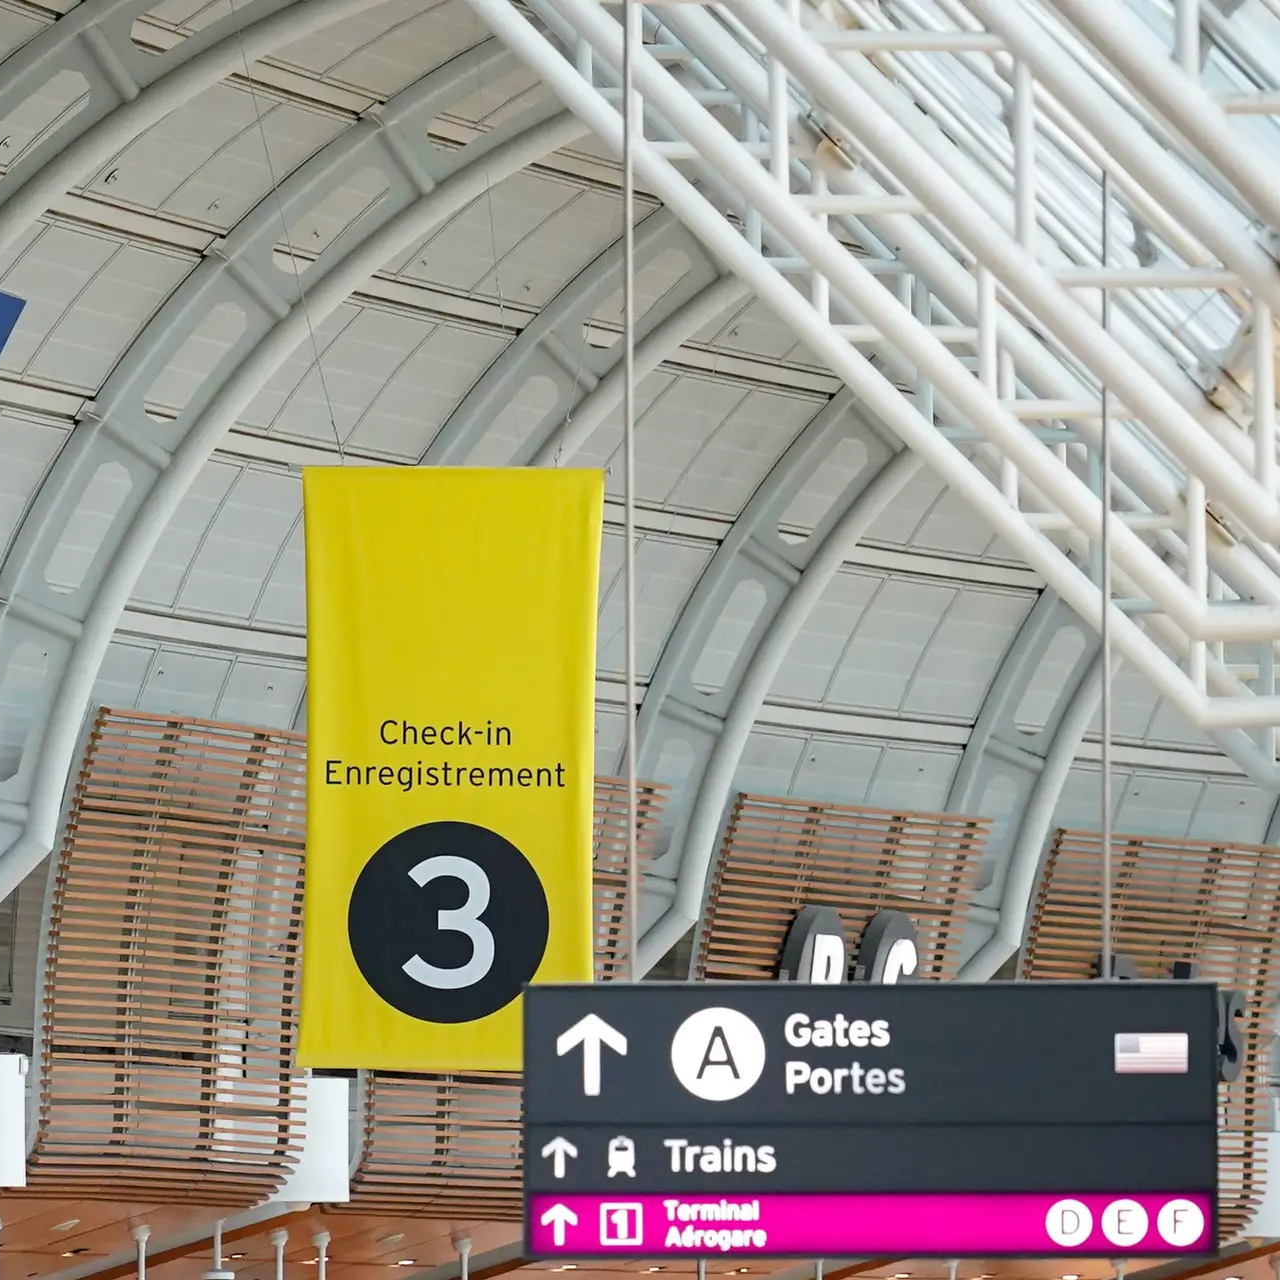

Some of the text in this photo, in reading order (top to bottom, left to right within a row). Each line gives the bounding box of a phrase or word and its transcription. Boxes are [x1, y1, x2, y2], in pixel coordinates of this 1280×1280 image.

[379, 719, 512, 747] Check-in
[325, 760, 566, 792] Enregistrement
[401, 855, 496, 990] 3
[696, 1013, 891, 1080] A Gates
[785, 1061, 906, 1095] Portes
[663, 1138, 777, 1173] Trains
[610, 1199, 760, 1240] 1 Terminal
[1061, 1209, 1189, 1235] D E F
[664, 1225, 768, 1252] Aérogare
